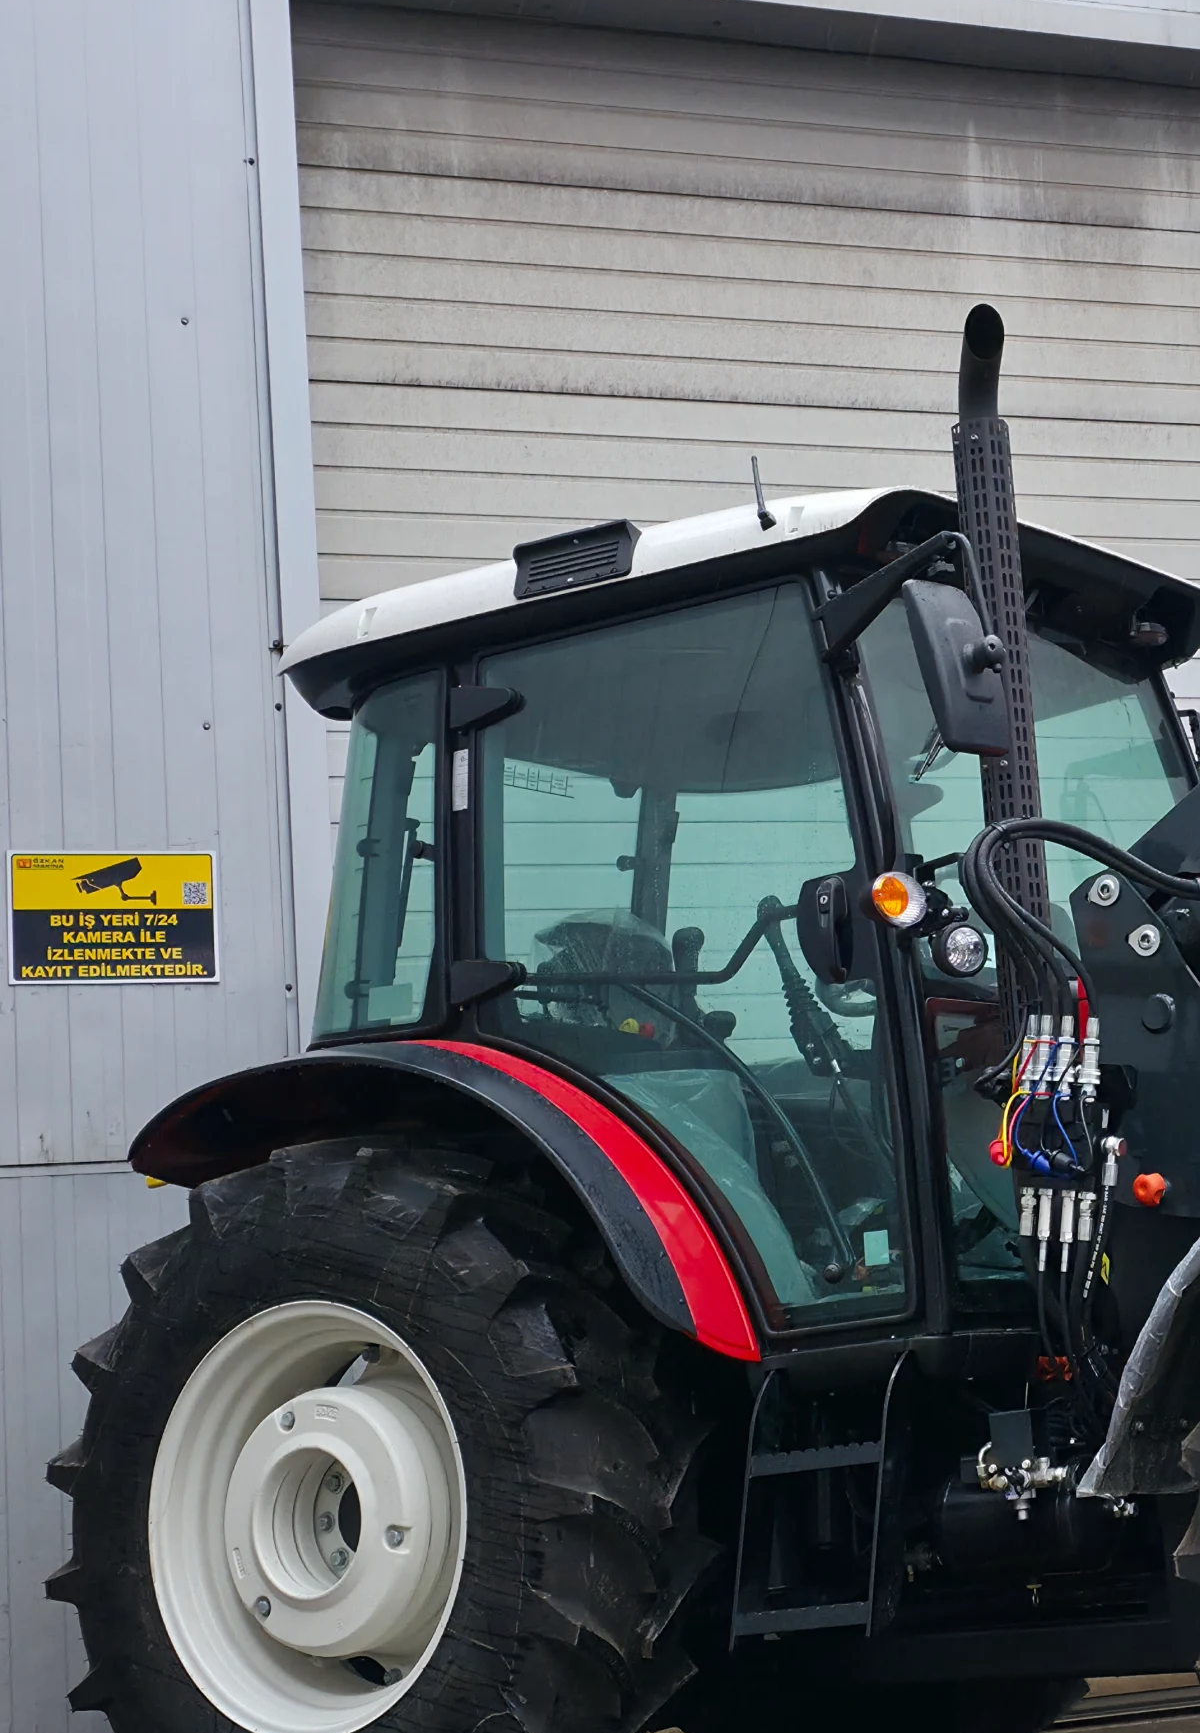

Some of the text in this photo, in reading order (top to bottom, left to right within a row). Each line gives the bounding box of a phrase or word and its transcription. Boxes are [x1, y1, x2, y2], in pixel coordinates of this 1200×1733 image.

[50, 911, 178, 929] BU İŞ YERİ 7/24
[63, 928, 166, 943] KAMERA İLE
[47, 946, 183, 960] İZLENMEKTE VE
[21, 961, 208, 978] KAYIT EDİLMEKTEDİR.
